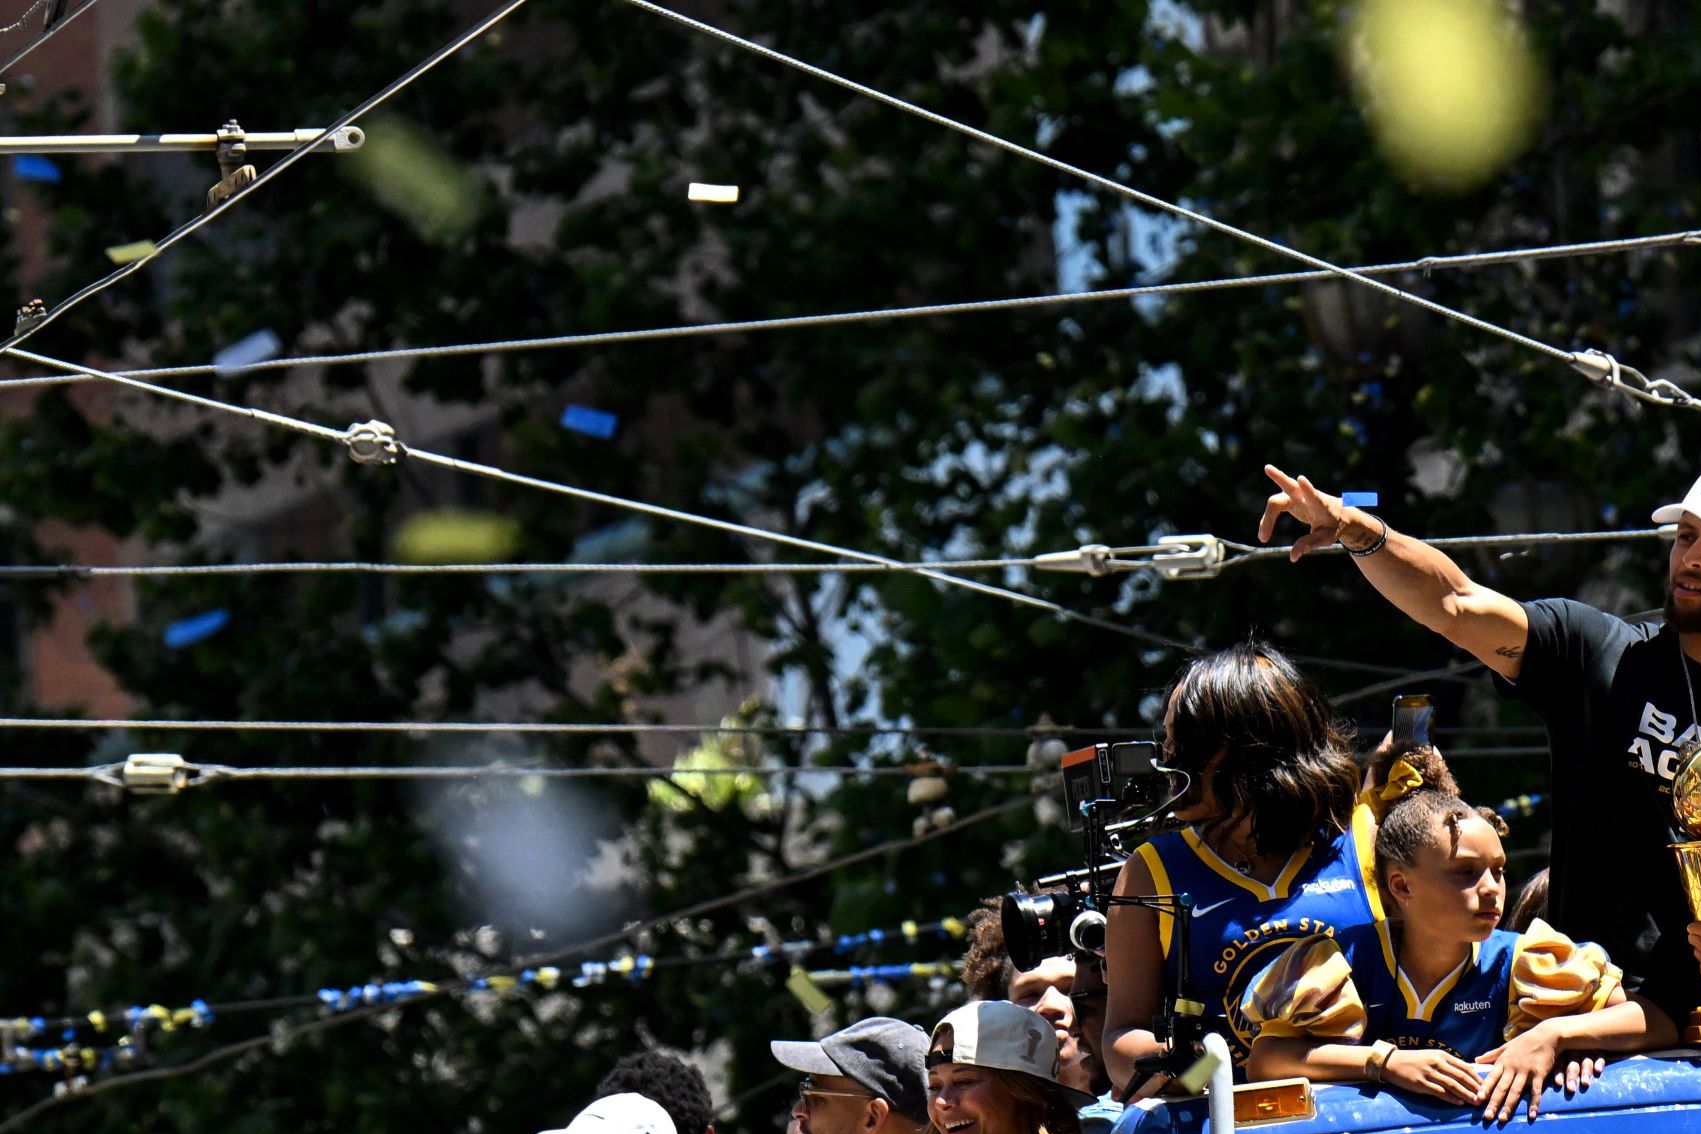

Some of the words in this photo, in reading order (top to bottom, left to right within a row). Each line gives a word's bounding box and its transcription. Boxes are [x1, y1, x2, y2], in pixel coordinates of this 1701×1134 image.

[1213, 919, 1288, 974] GOLDEN
[1300, 918, 1341, 938] STA
[1454, 1001, 1491, 1013] Rakuten
